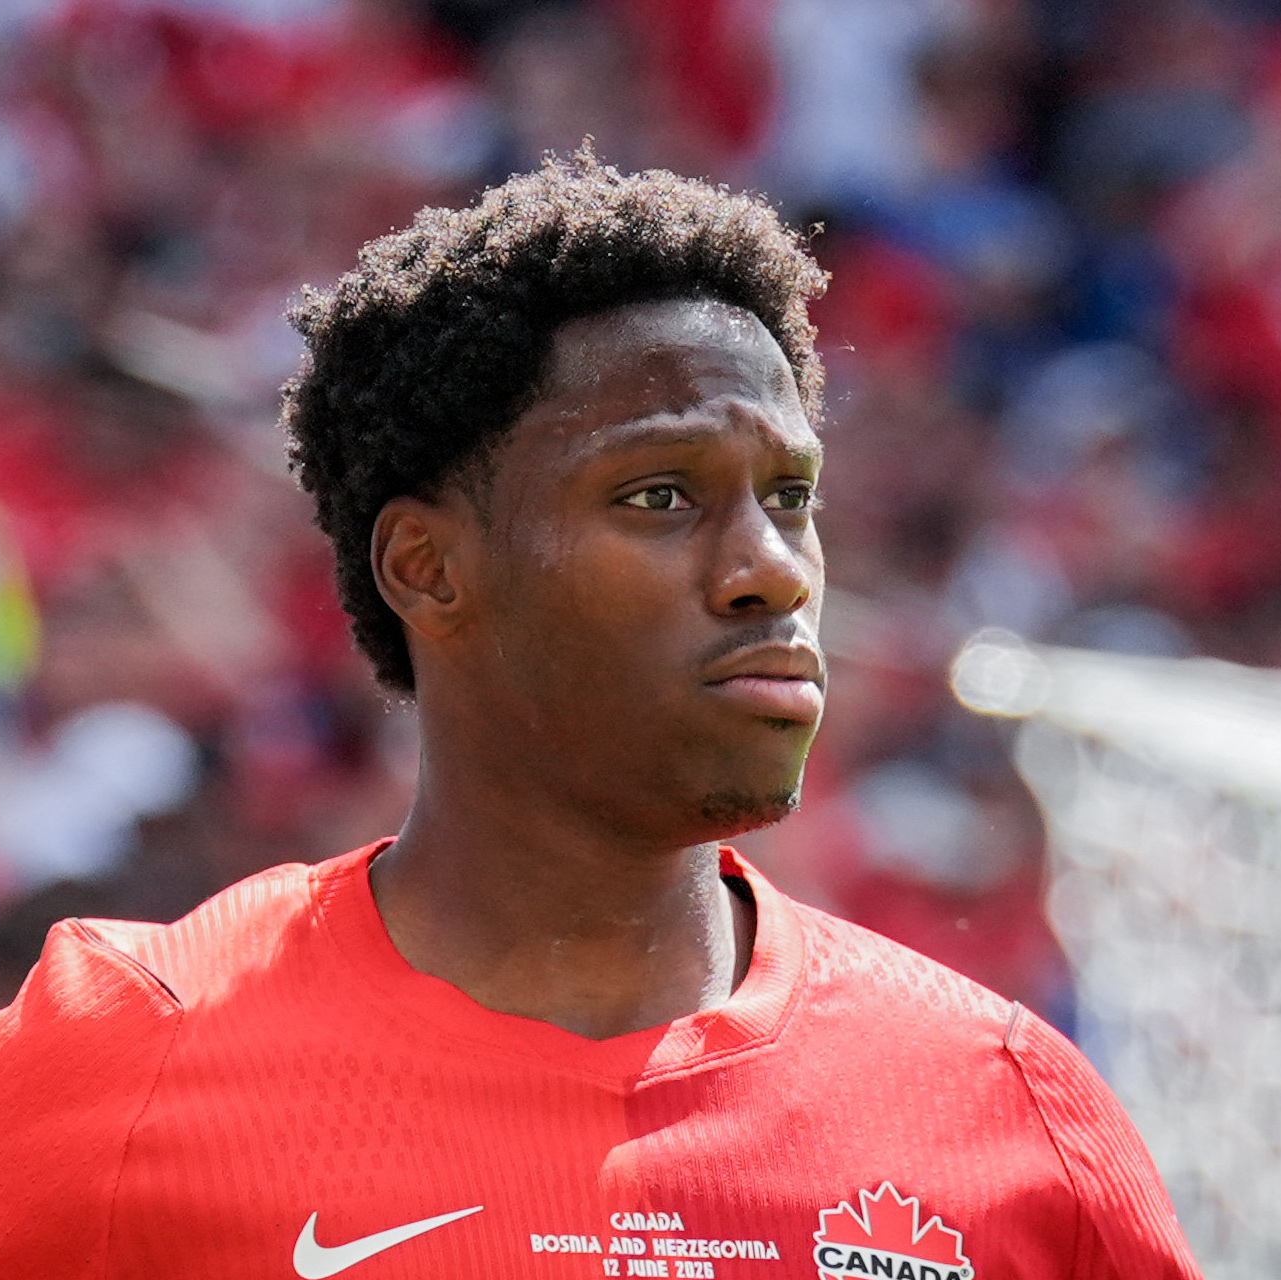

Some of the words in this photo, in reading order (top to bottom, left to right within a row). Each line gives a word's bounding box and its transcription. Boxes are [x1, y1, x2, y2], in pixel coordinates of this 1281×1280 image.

[610, 1212, 685, 1231] CANADA
[530, 1234, 602, 1253] BOSNIA
[608, 1237, 646, 1255] AND
[652, 1238, 780, 1260] HERZEGOVINA
[602, 1259, 620, 1277] 12
[627, 1259, 669, 1278] JUNE
[674, 1260, 715, 1279] 2026
